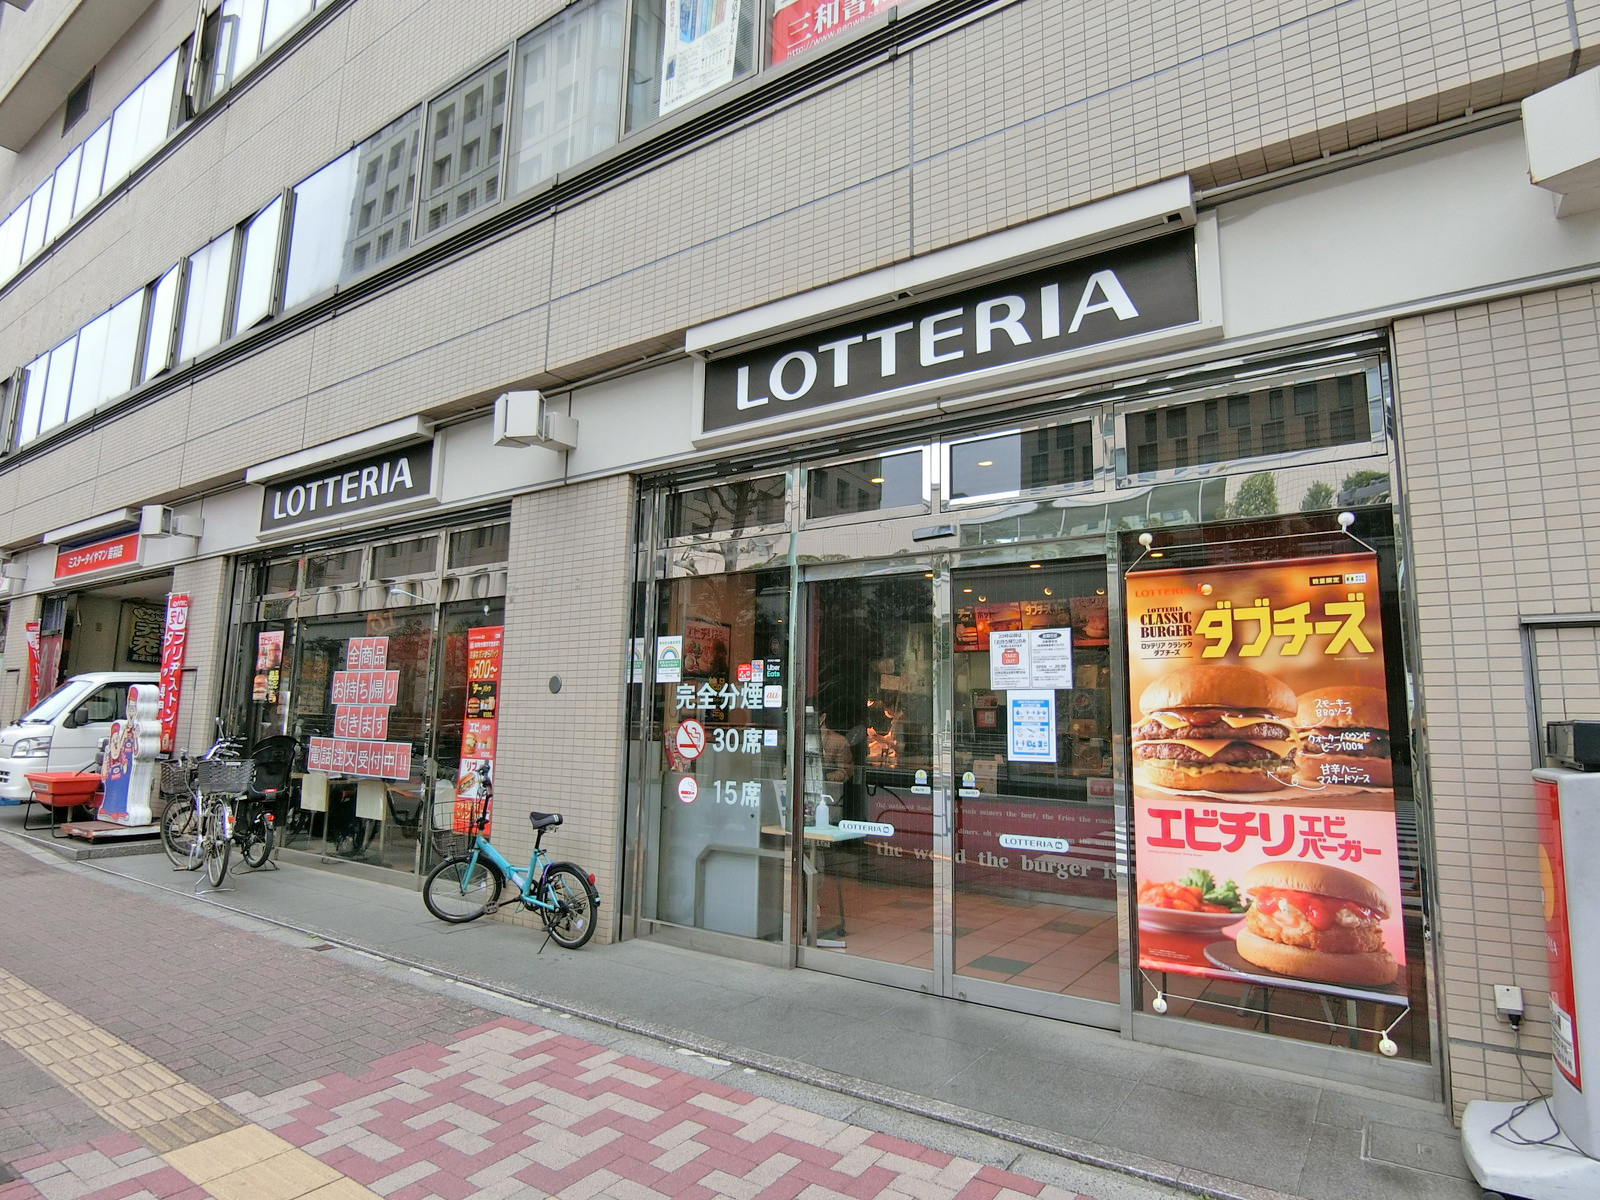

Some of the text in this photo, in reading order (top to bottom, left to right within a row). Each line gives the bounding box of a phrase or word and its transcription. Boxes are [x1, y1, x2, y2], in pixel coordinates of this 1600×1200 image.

[787, 0, 880, 48] 三和書
[736, 269, 1139, 411] LOTTERIA
[273, 457, 413, 520] LOTTERIA
[68, 544, 124, 568] ミスタータイヤマン 音羽店
[1312, 577, 1340, 585] 数量限定
[1135, 586, 1192, 598] LOTTERIA
[1140, 611, 1192, 626] CLASSIC
[1194, 592, 1375, 659] ダブチーズ
[1141, 625, 1193, 638] BURGER
[348, 645, 385, 666] 全商品
[1141, 641, 1193, 650] ロッテリア クラシック
[333, 679, 395, 700] お持ち帰り
[675, 682, 763, 710] 完全分煙
[1314, 699, 1350, 708] スモーキー
[1316, 707, 1352, 717] BBQソース
[337, 713, 386, 735] できます
[712, 728, 763, 754] 30席
[1321, 742, 1364, 752] ビーフ100%
[1316, 774, 1370, 785] マスタードソース
[1320, 764, 1364, 775] 甘辛ハニー
[713, 780, 762, 807] 15席
[1006, 810, 1018, 818] the
[1020, 811, 1039, 820] beef,
[1042, 812, 1054, 820] the
[1057, 813, 1075, 821] fries
[1079, 814, 1091, 823] the
[1299, 815, 1347, 838] エビ
[843, 823, 882, 833] LOTTERIA
[1146, 807, 1295, 857] エビチリ
[1004, 837, 1053, 849] LOTTERIA
[1298, 838, 1382, 862] バーガー
[877, 841, 903, 857] the
[978, 851, 1009, 868] the
[1020, 854, 1091, 880] burger
